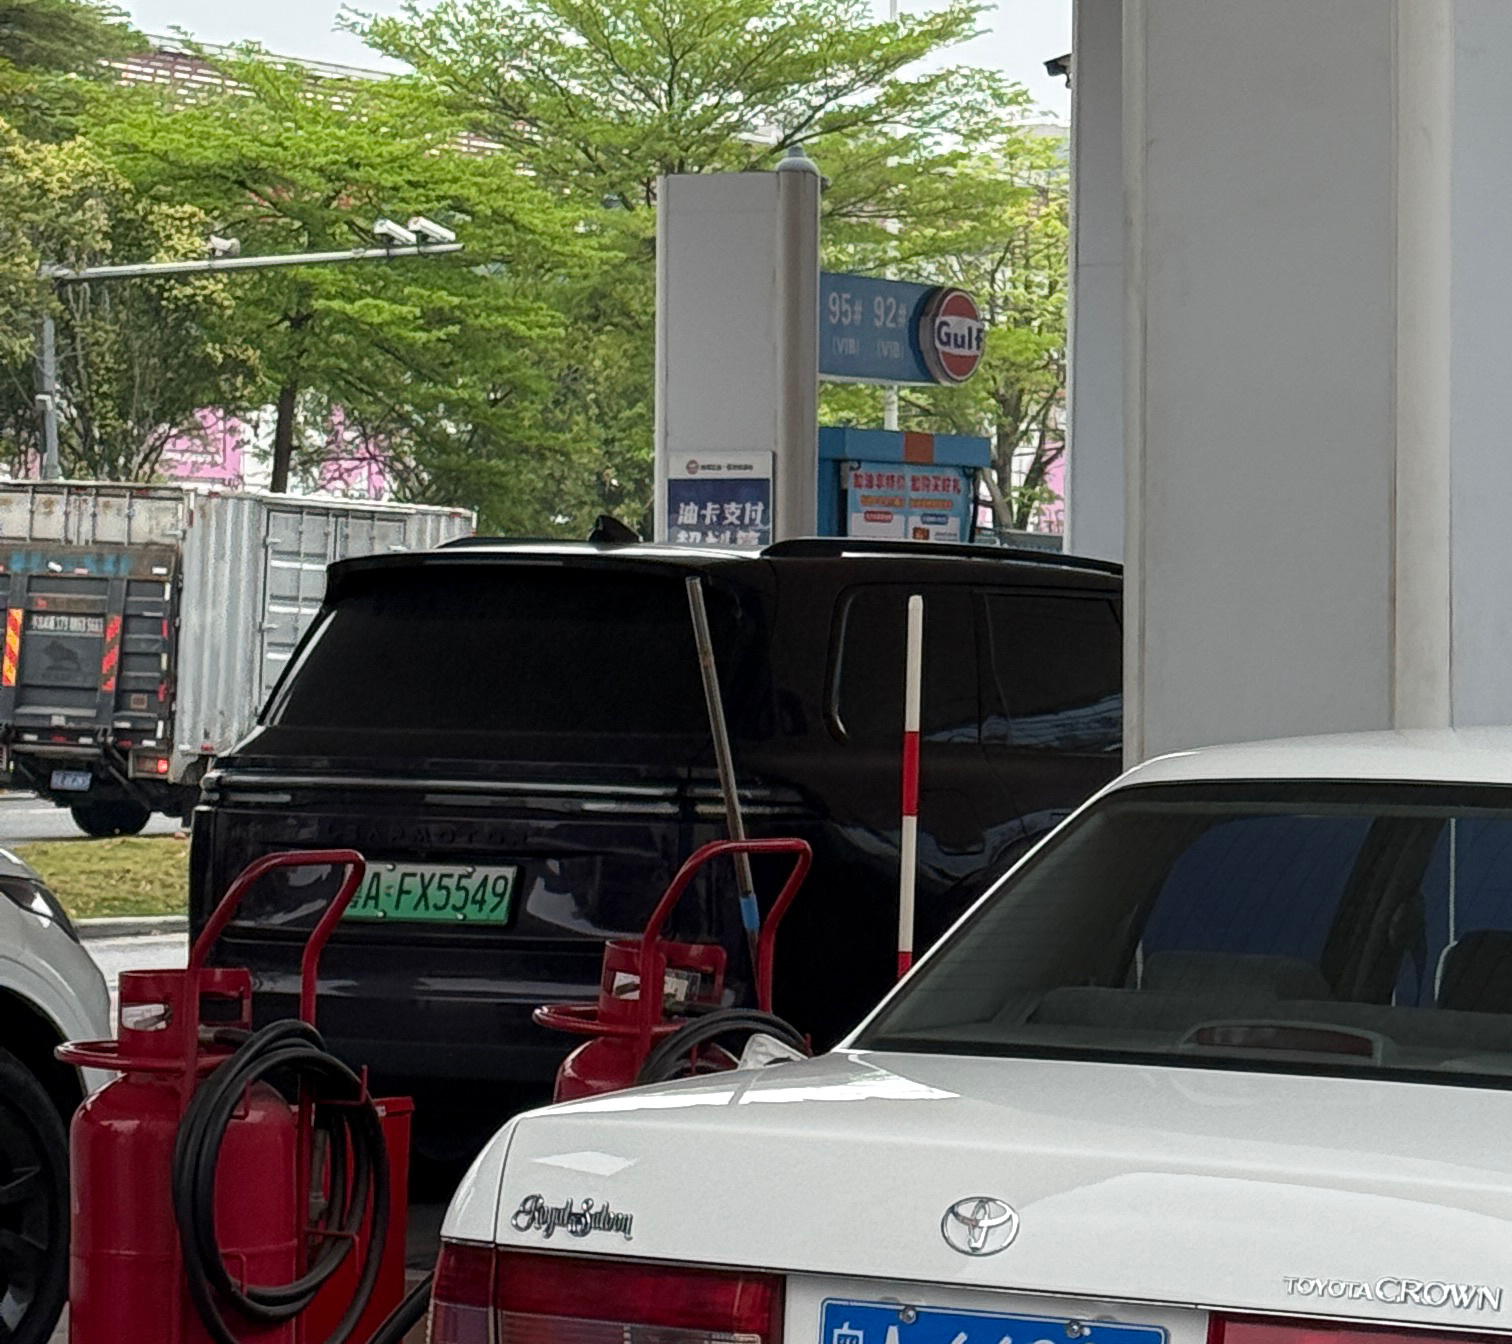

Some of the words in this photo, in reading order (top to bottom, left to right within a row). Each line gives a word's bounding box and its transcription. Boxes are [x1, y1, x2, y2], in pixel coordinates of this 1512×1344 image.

[828, 292, 862, 326] 95#
[873, 296, 907, 328] 92#
[936, 319, 985, 352] Gulf
[677, 501, 765, 526] 油卡支付
[1283, 1276, 1374, 1301] TOYOTA
[1375, 1277, 1504, 1312] CROWN
